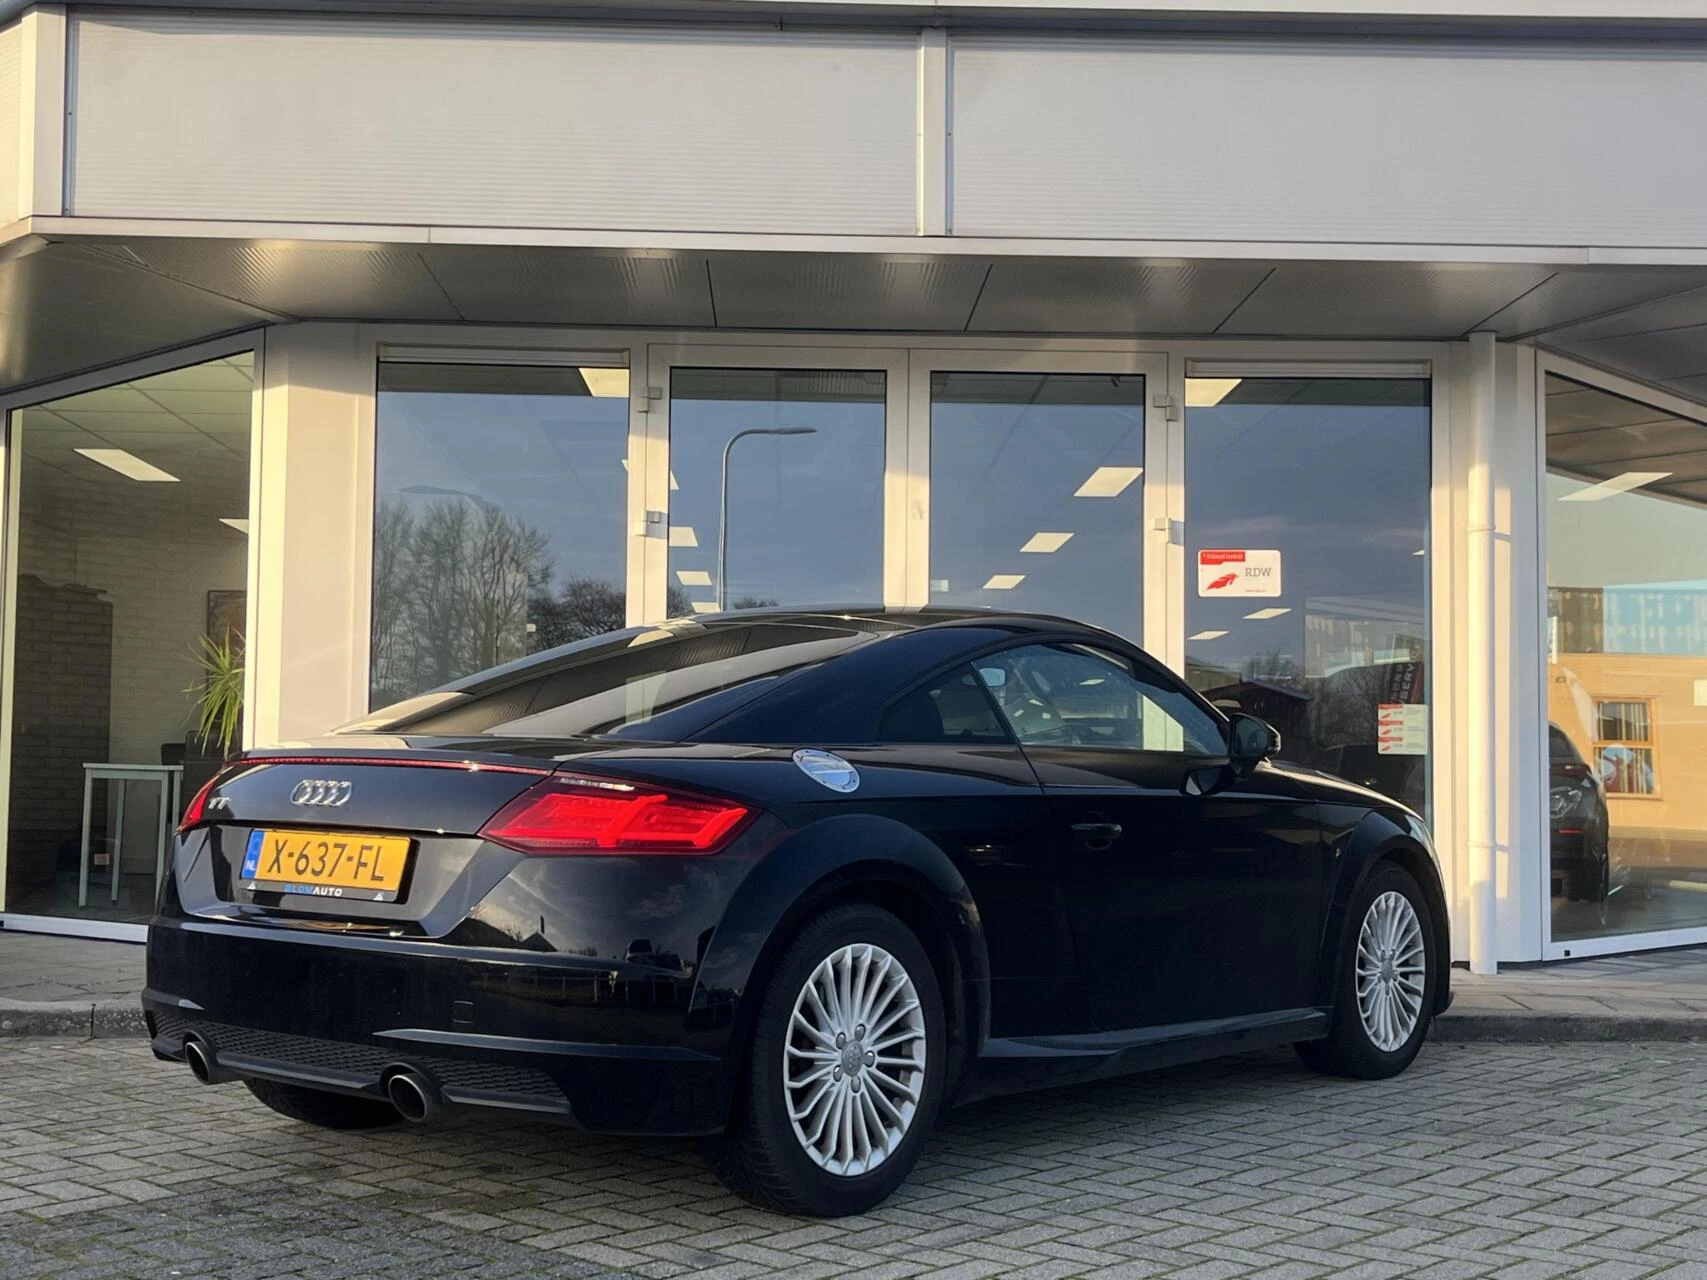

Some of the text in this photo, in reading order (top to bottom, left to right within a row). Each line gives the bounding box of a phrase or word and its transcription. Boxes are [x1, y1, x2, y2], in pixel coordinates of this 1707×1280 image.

[1245, 567, 1272, 577] RDW
[208, 796, 231, 810] TT
[245, 860, 256, 871] NL
[267, 839, 385, 882] X-637-FL
